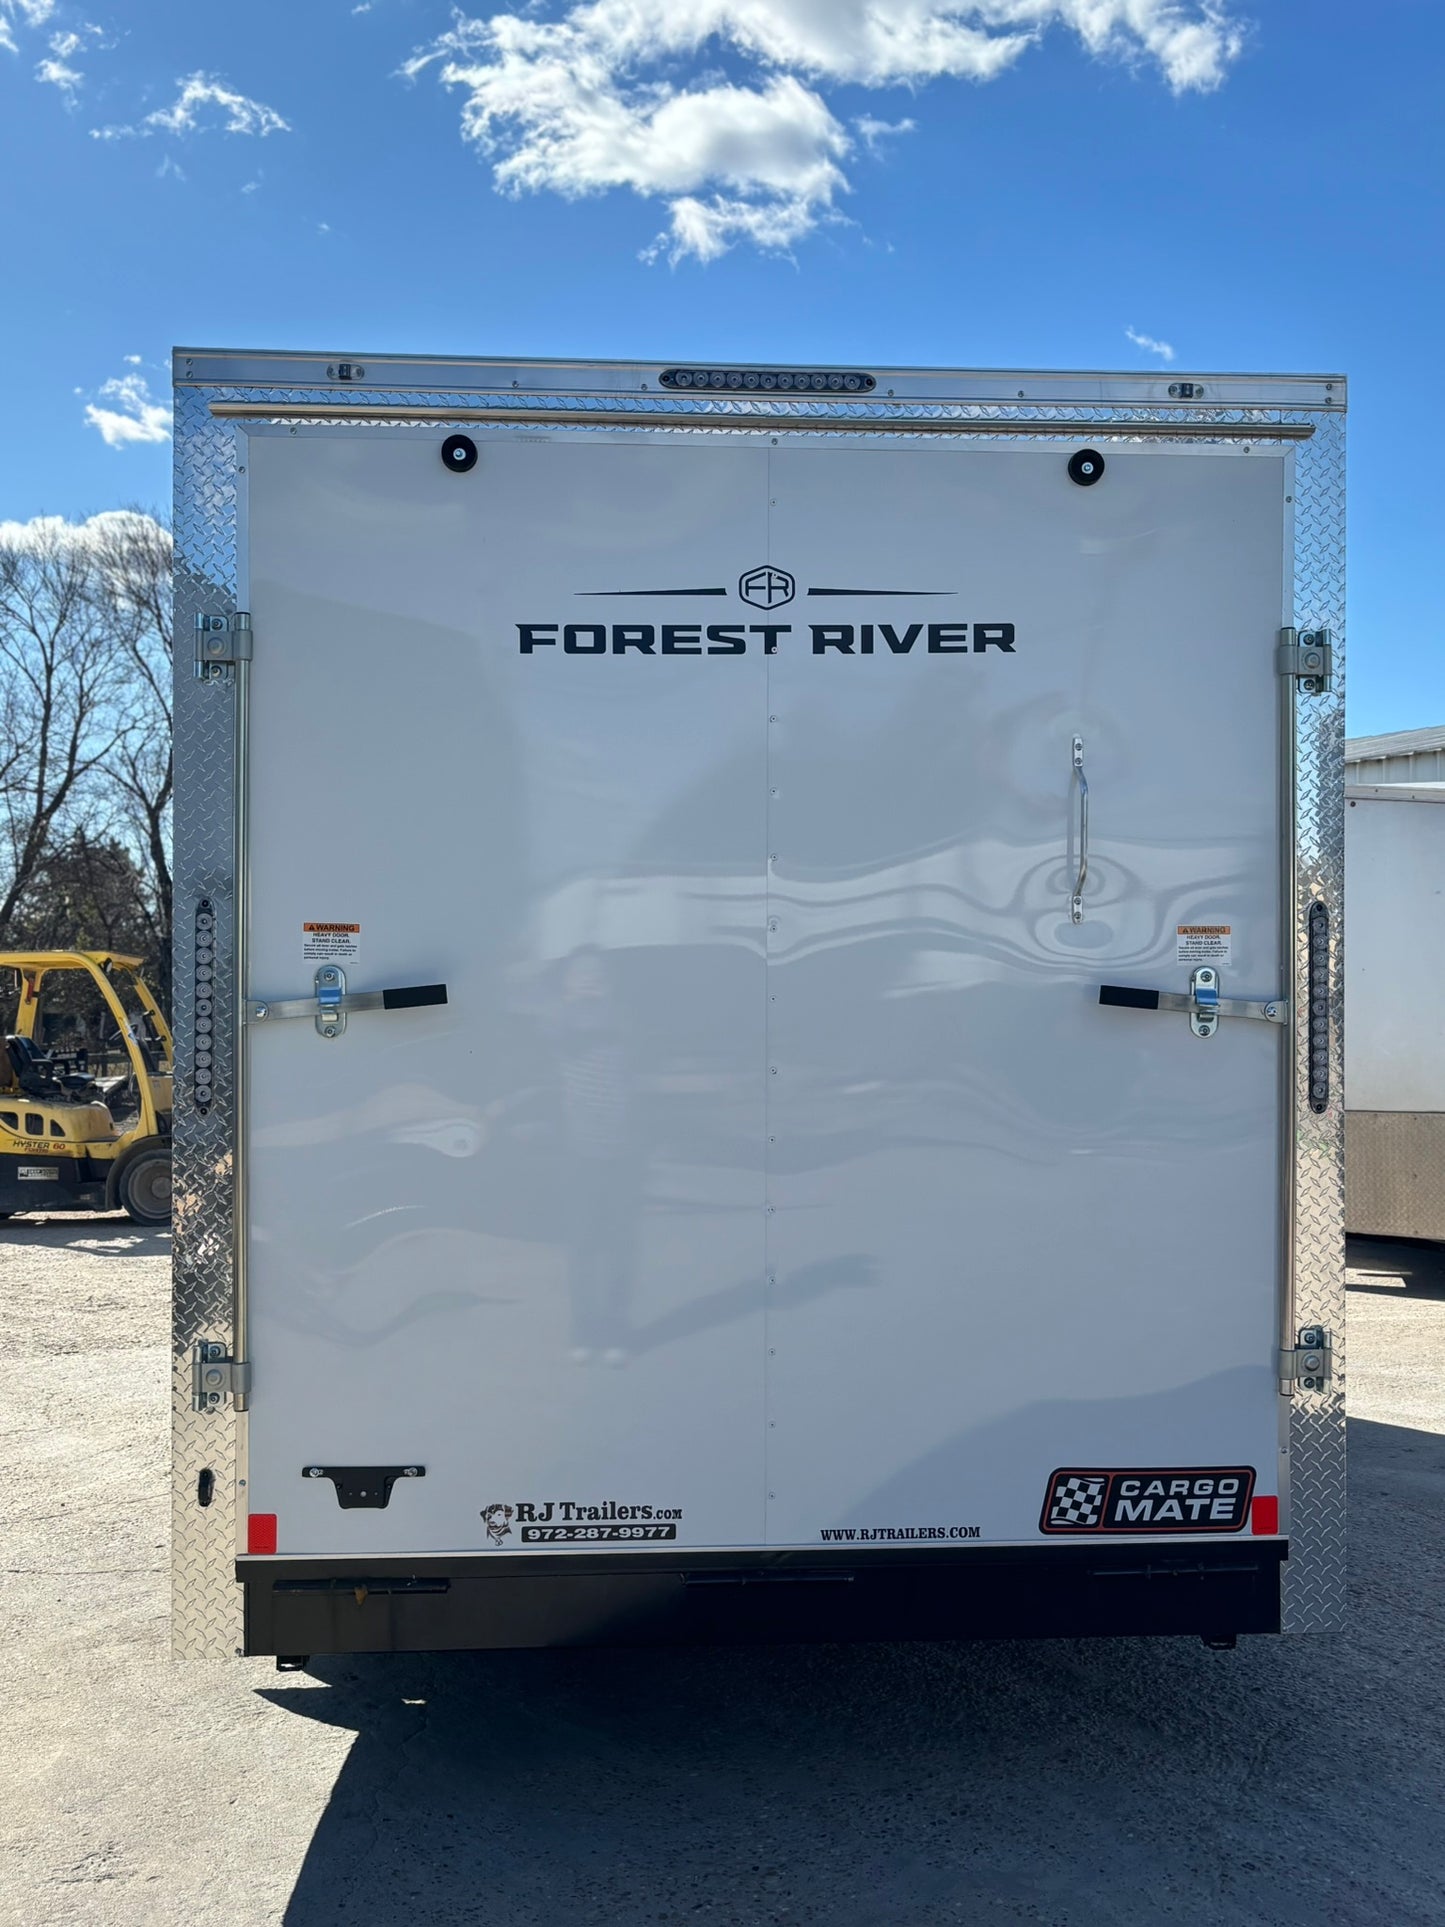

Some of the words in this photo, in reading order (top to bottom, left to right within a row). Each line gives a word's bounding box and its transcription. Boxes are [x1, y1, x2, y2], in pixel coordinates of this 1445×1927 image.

[514, 623, 792, 655] FOREST
[807, 622, 1017, 655] RIVER
[317, 924, 355, 932] WARNING
[1119, 1478, 1240, 1496] CARGO
[515, 1502, 555, 1522] RJ
[1114, 1497, 1237, 1521] MATE
[527, 1526, 670, 1540] 972-287-9977
[820, 1526, 981, 1541] WWW.RJTRAILERS.COM
